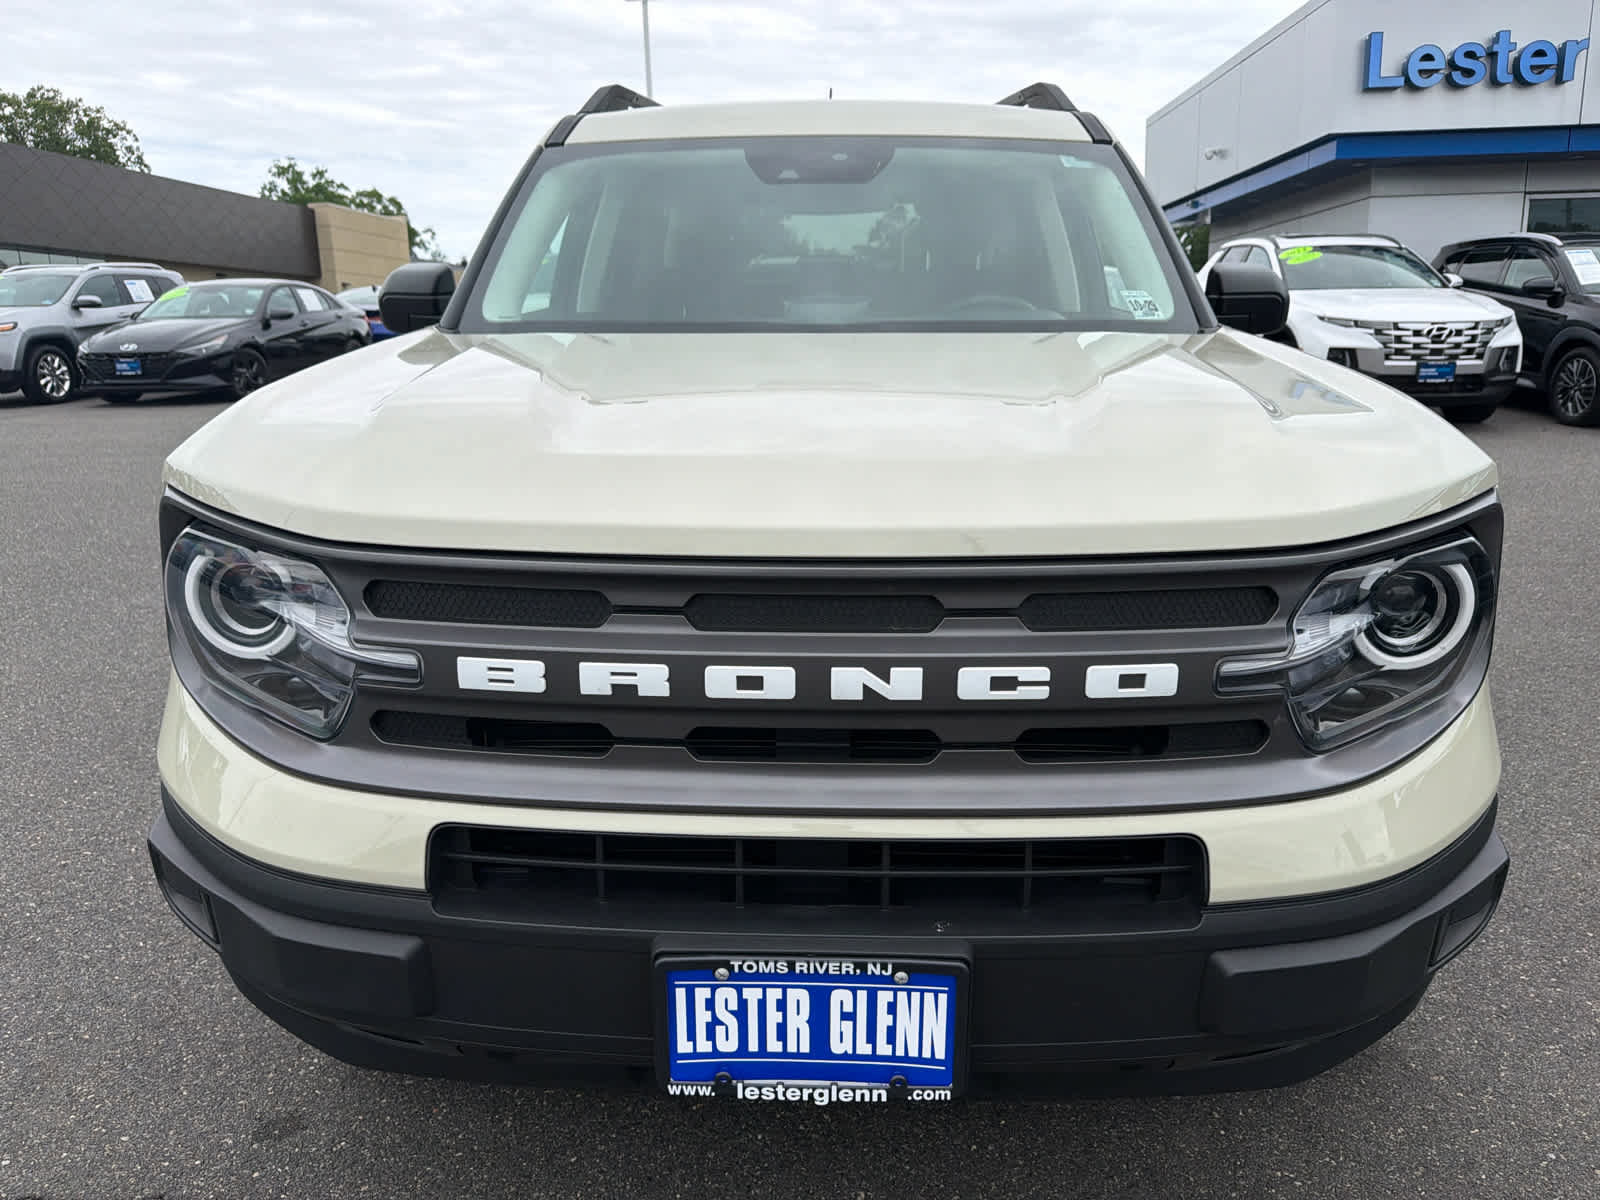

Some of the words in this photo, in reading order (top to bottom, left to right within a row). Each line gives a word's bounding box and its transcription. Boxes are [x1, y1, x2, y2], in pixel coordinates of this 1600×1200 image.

[1364, 29, 1590, 90] Lester
[456, 656, 1179, 701] BRONCO
[730, 960, 789, 975] TOMS
[795, 961, 861, 976] RIVER,
[867, 961, 893, 976] NJ
[674, 986, 810, 1054] LESTER
[829, 988, 948, 1060] GLENN
[667, 1084, 716, 1097] www.
[736, 1082, 888, 1106] lesterglenn
[907, 1087, 952, 1102] .com
